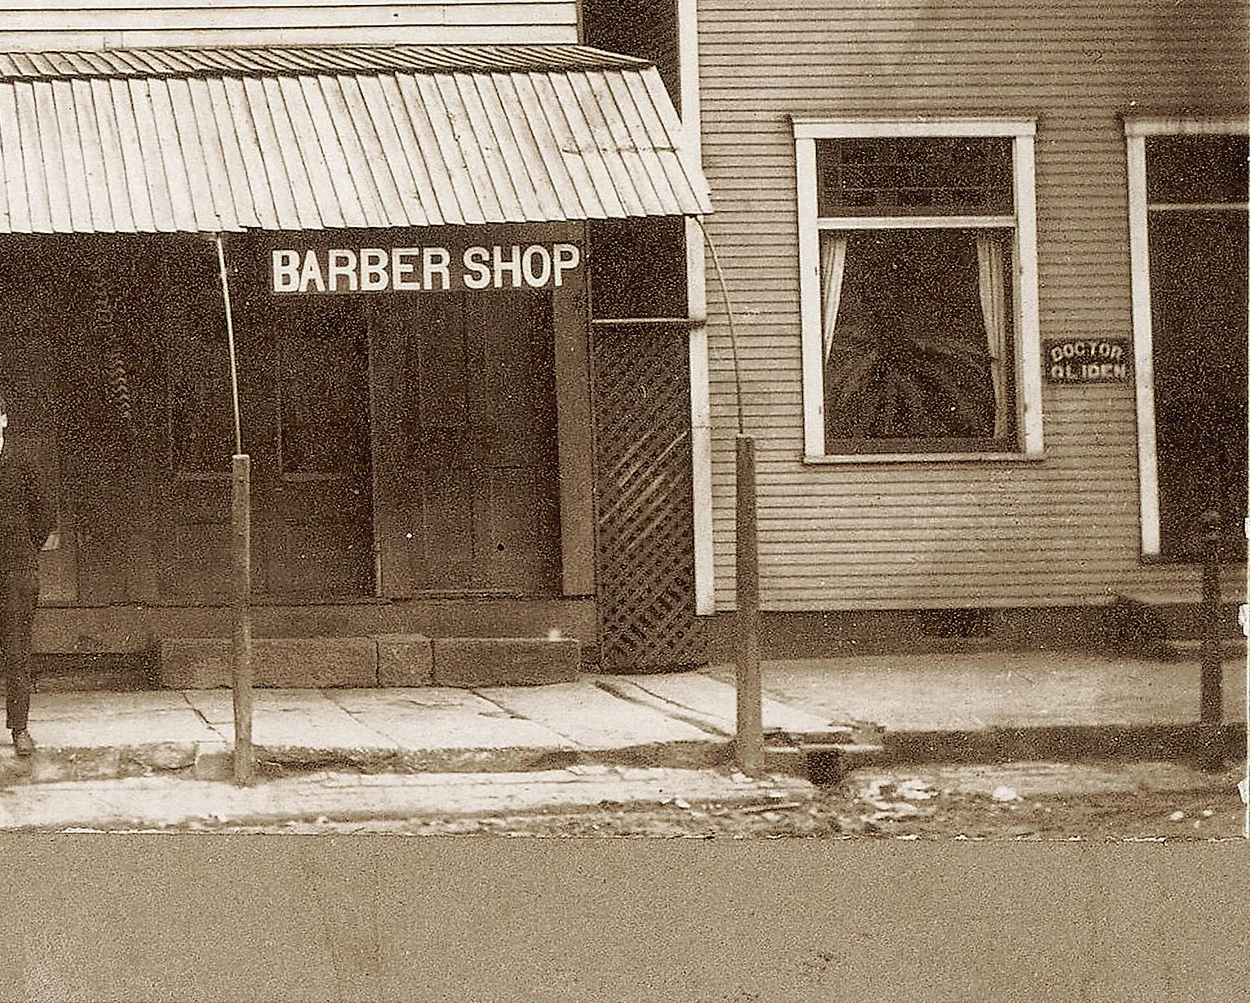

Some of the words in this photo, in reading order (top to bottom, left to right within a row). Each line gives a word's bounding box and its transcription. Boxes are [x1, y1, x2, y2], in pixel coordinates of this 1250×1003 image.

[271, 247, 451, 293] BARBER
[462, 243, 581, 289] SHOP
[1050, 341, 1124, 362] DOCTOR
